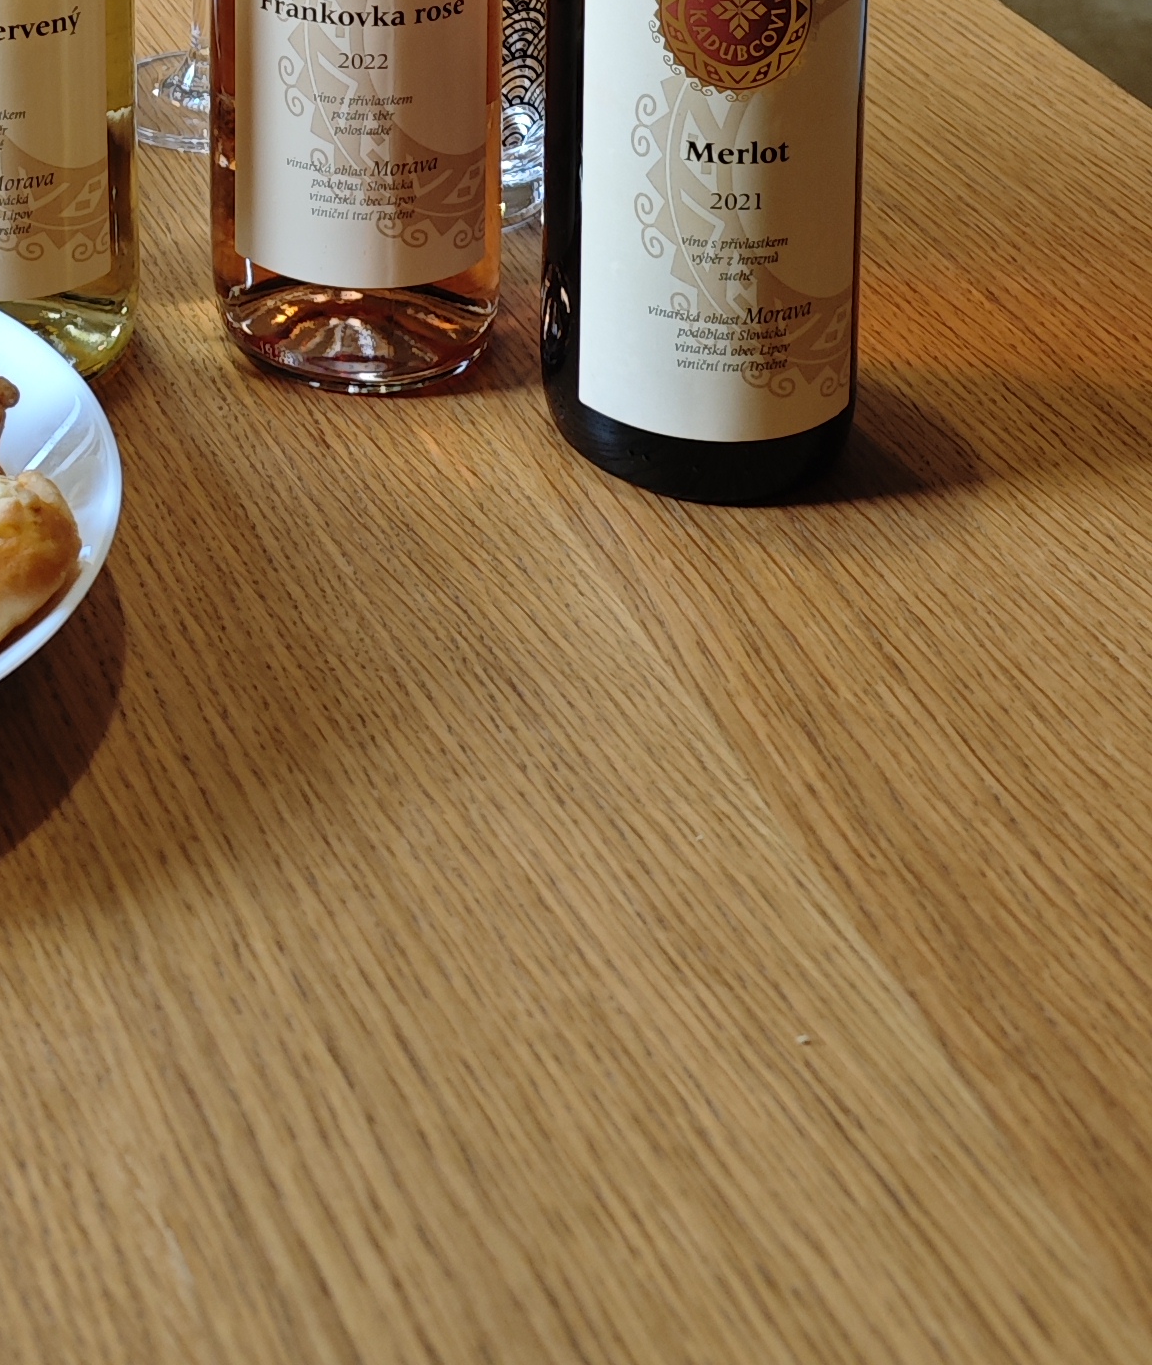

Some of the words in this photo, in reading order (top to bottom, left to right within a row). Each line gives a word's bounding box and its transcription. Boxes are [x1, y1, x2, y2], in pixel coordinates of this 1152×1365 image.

[689, 8, 787, 61] KADUBCOVI
[337, 52, 389, 70] 2022
[313, 92, 337, 105] víno
[339, 96, 345, 105] s
[347, 94, 414, 108] přívlastkem
[330, 109, 370, 122] pozdní
[372, 109, 396, 121] sběr
[333, 124, 394, 137] polosladké
[683, 139, 790, 165] Merlot
[286, 156, 332, 175] vinařská
[333, 165, 369, 177] oblast
[369, 156, 439, 178] Morava
[310, 178, 363, 192] podoblast
[309, 191, 356, 206] vinařská
[359, 195, 383, 207] obec
[709, 192, 763, 211] 2021
[310, 205, 350, 220] viniční
[681, 234, 709, 248] víno
[711, 238, 718, 249] s
[719, 235, 789, 252] přívlastkem
[691, 251, 725, 266] výběr
[726, 255, 733, 266] z
[736, 251, 779, 266] hroznů
[718, 269, 754, 282] suché
[647, 304, 701, 323] vinařská
[703, 311, 741, 326] oblast
[741, 301, 812, 326] Morava
[676, 326, 736, 341] podoblast
[674, 340, 727, 357] vinařská
[730, 345, 756, 357] obec
[676, 357, 720, 372] viniční
